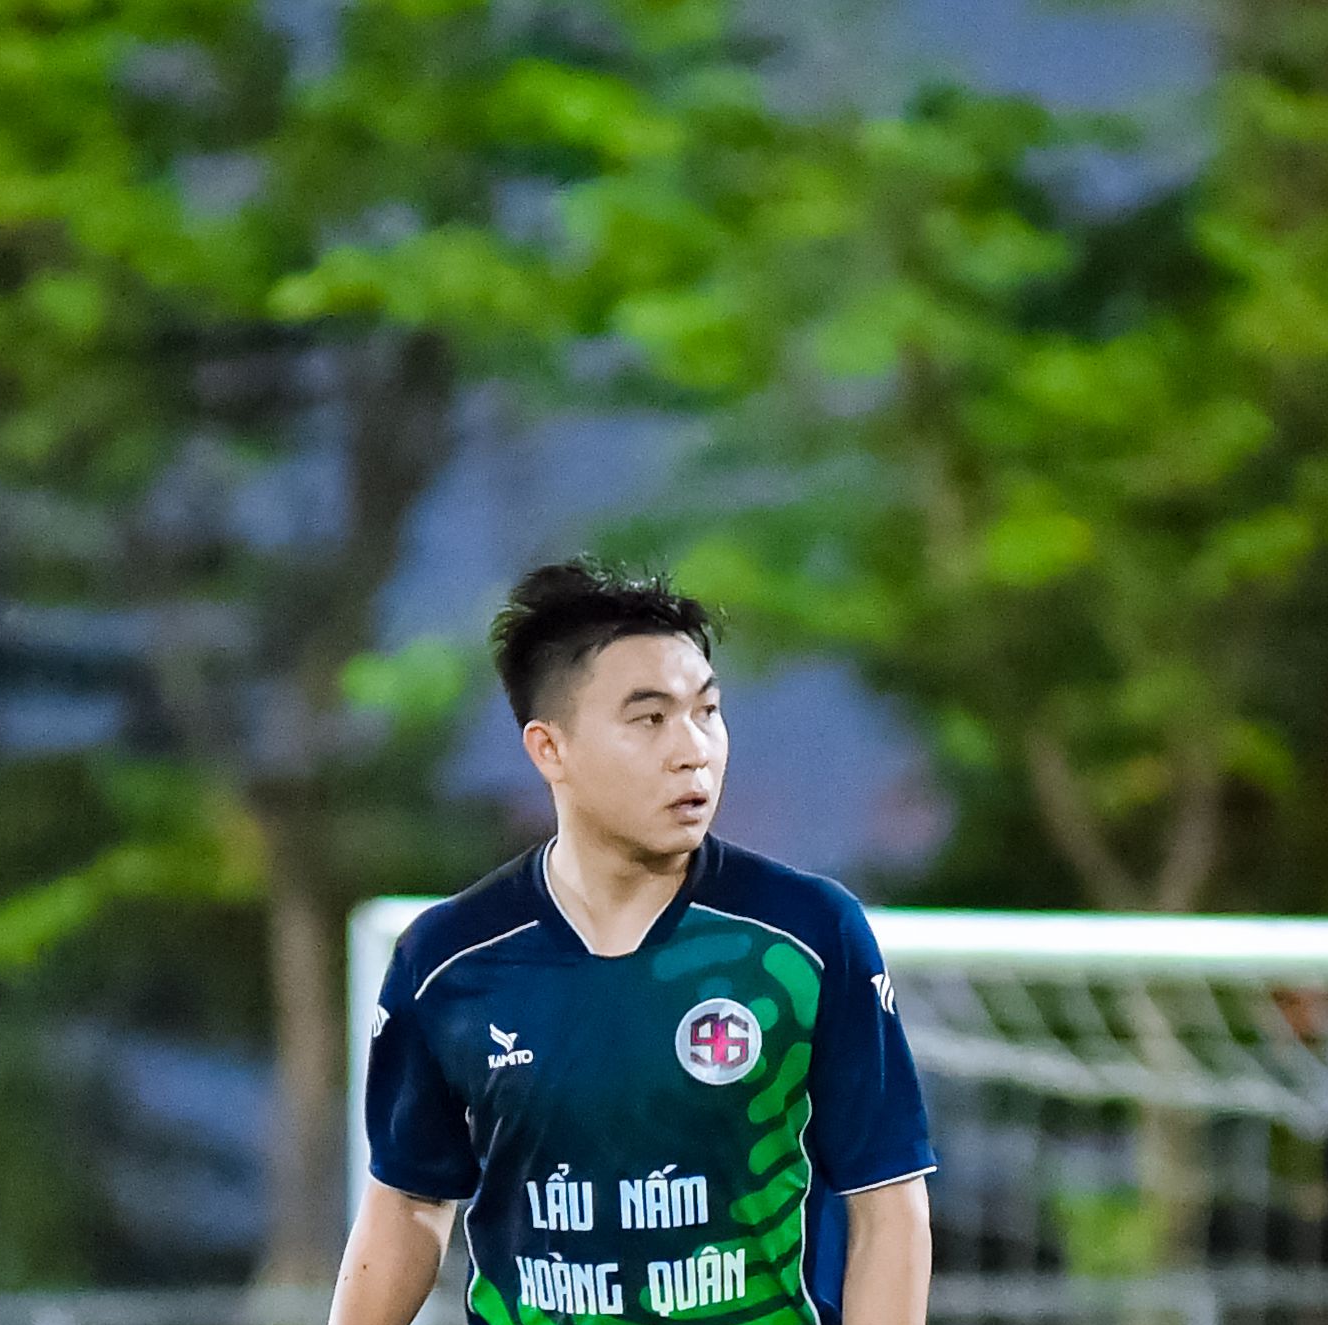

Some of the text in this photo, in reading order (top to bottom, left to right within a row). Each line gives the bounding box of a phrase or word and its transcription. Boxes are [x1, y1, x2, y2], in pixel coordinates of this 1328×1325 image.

[526, 1163, 709, 1231] LẨU NẤM
[515, 1245, 746, 1317] HOÀNG QUÂN
